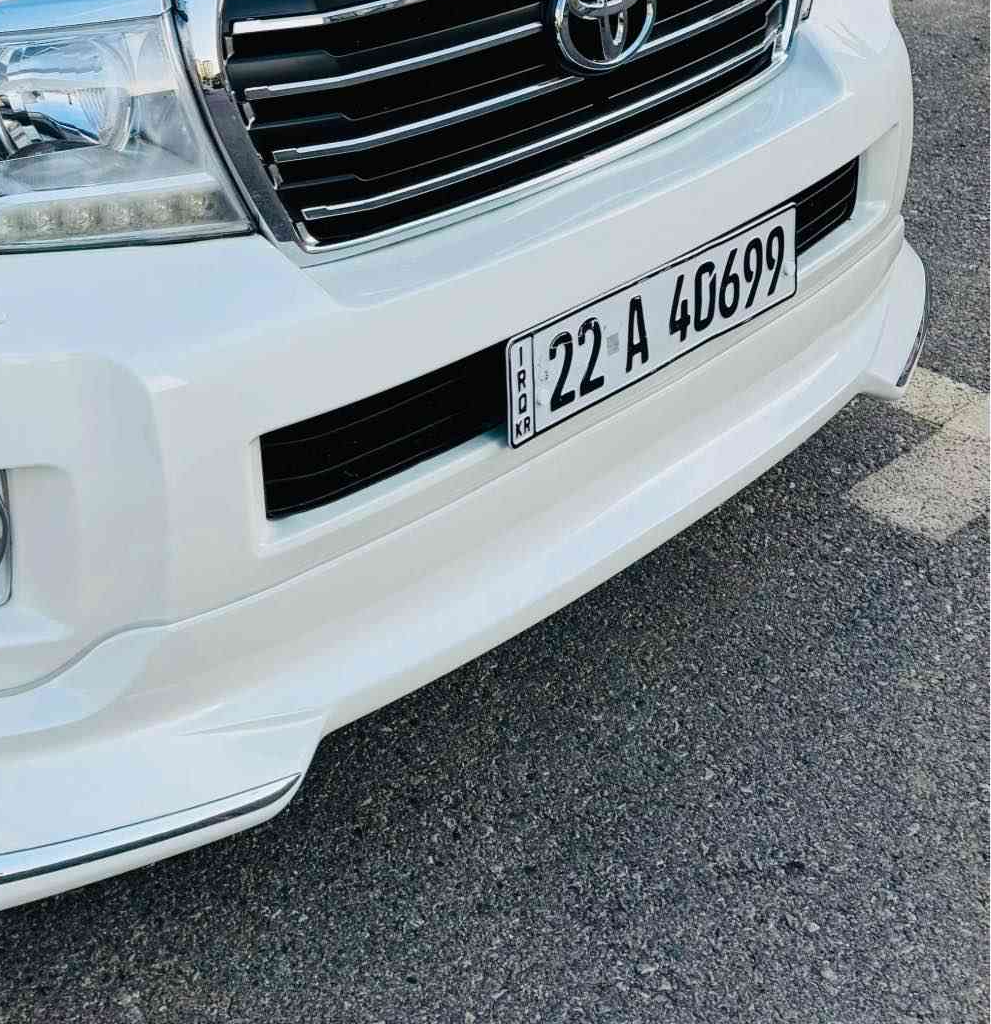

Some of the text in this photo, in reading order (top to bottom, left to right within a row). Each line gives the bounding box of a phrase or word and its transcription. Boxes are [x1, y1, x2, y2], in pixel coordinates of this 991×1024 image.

[549, 225, 785, 412] 22 A 40699
[515, 416, 531, 439] KR
